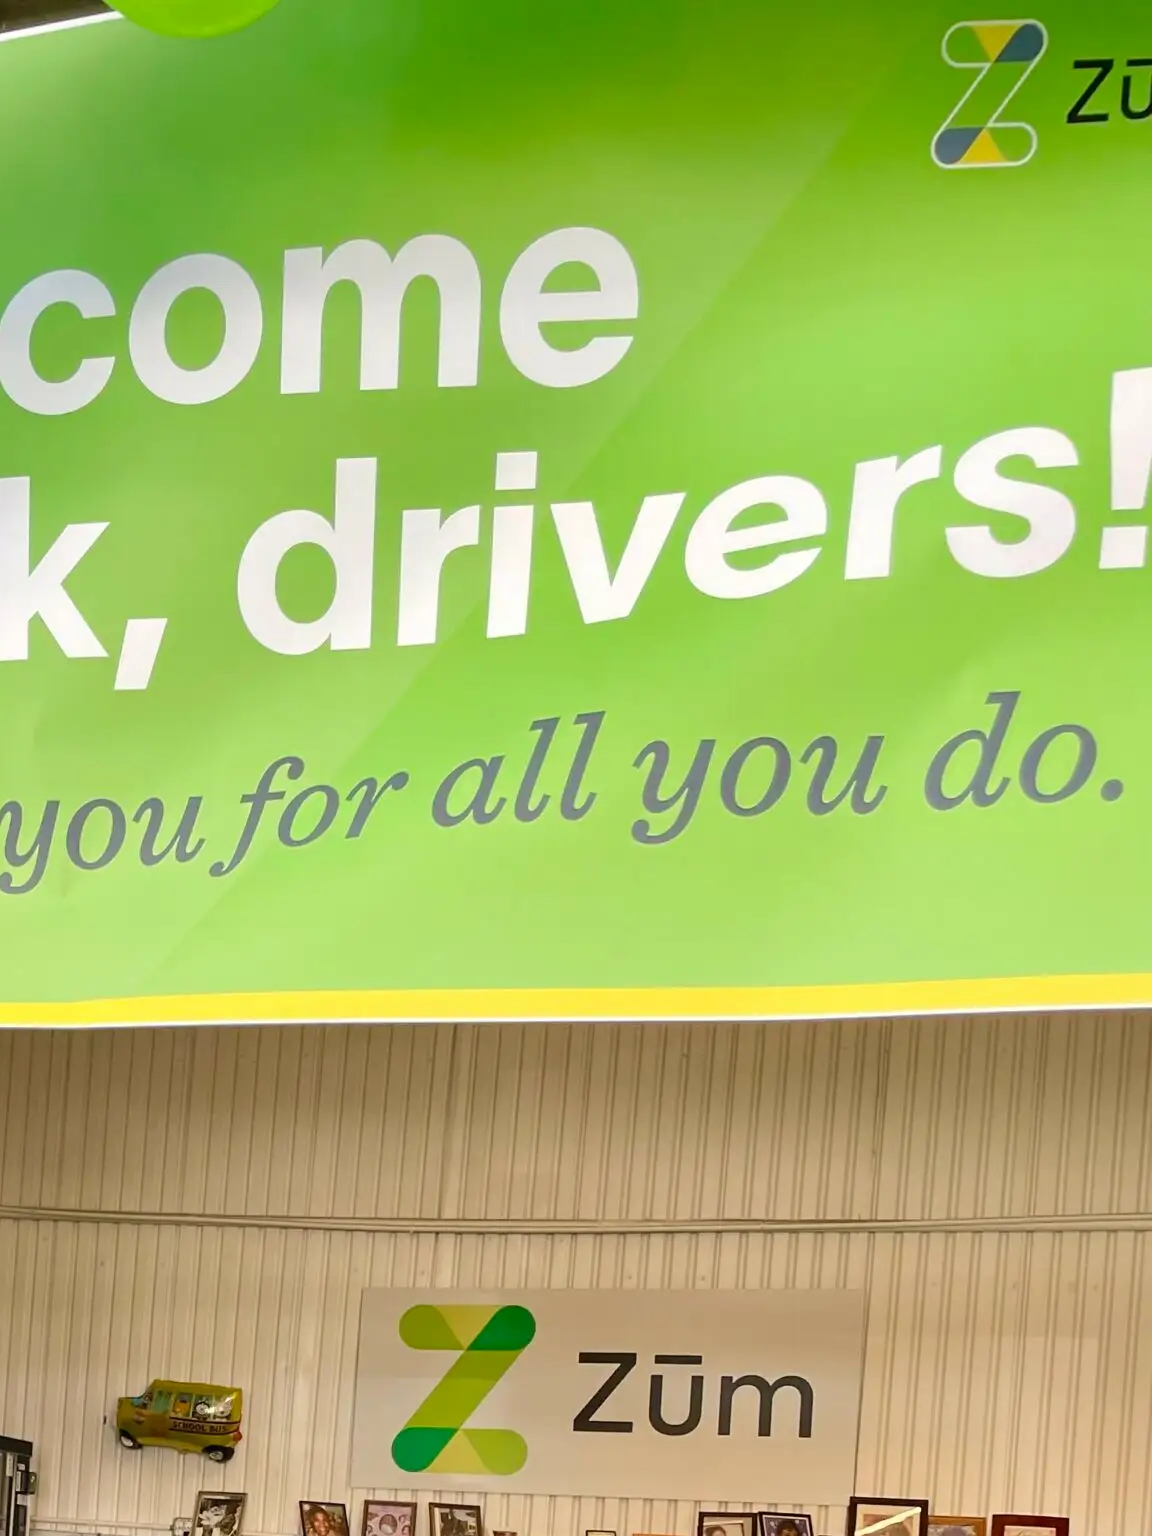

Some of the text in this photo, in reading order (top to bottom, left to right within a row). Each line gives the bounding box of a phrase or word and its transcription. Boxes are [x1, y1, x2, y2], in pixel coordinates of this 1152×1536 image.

[237, 367, 1152, 655] drivers!
[210, 755, 408, 876] for
[433, 712, 604, 827] all
[632, 735, 886, 845] you
[924, 691, 1123, 810] do.
[572, 1352, 814, 1438] Zūm
